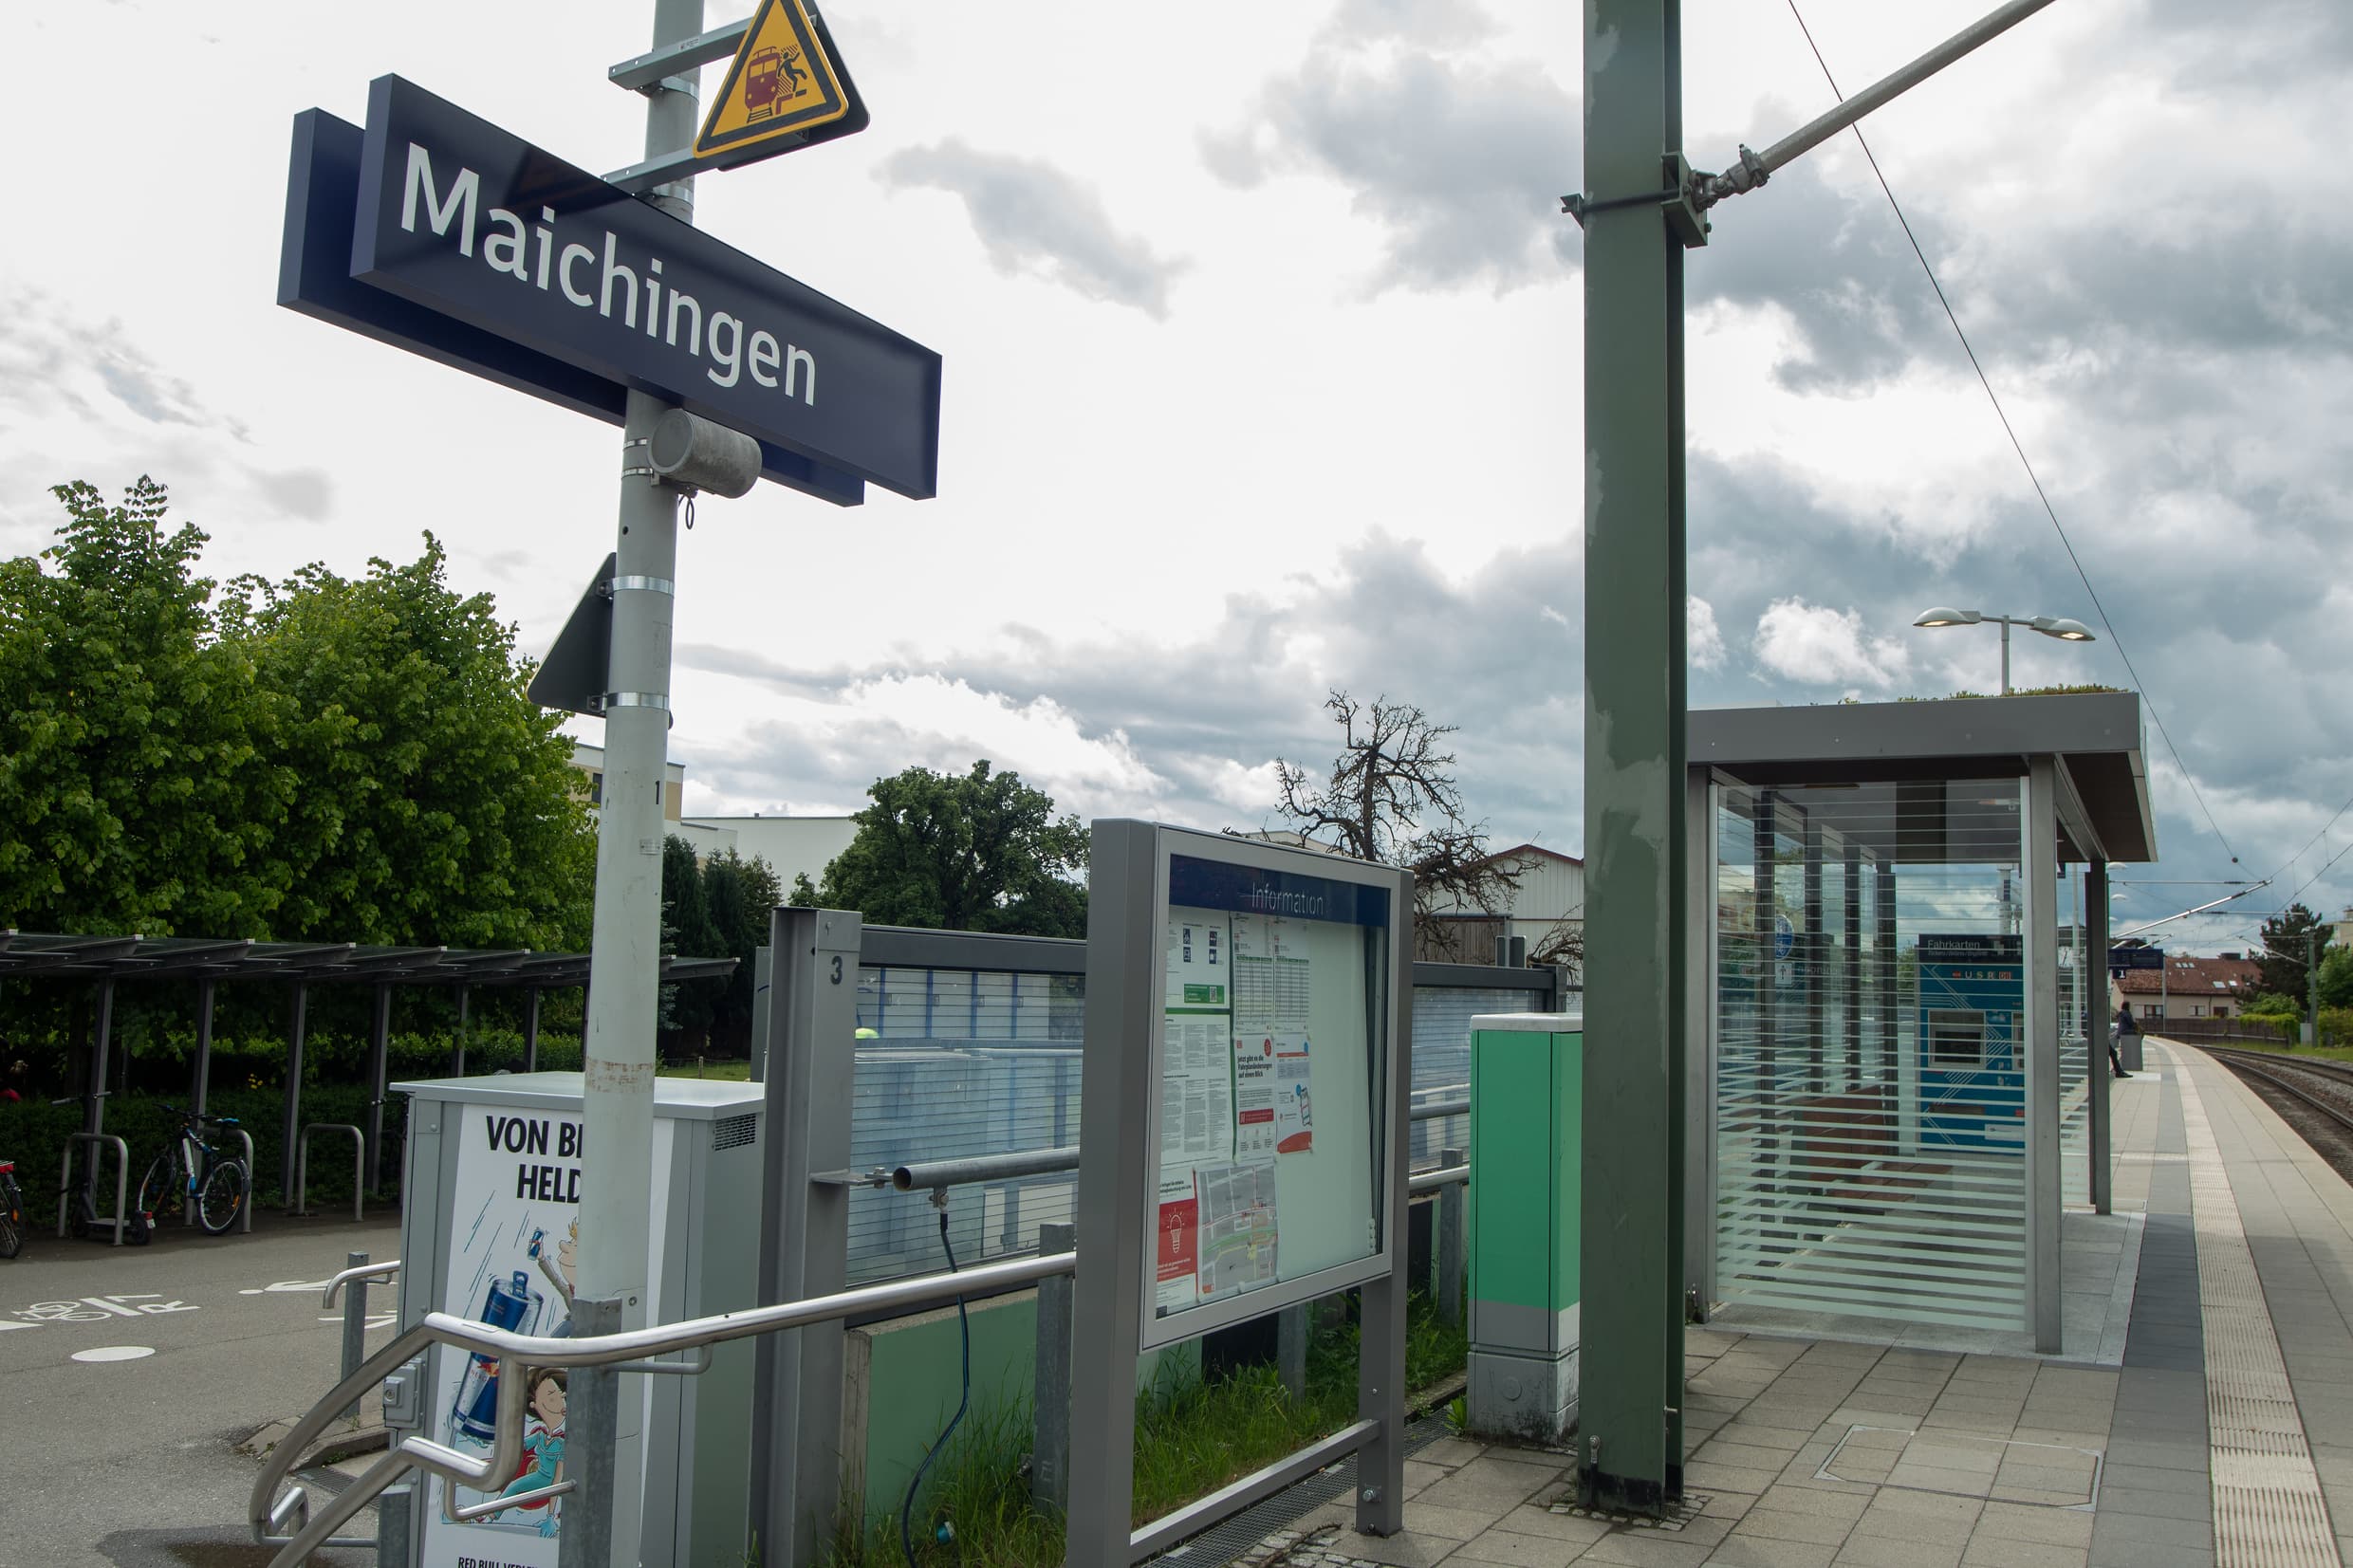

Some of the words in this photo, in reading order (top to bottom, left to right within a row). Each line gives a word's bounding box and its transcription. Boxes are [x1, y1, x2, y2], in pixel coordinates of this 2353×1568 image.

[400, 141, 817, 406] Maichingen
[1251, 880, 1324, 916] Information
[1927, 939, 1980, 950] Fahrkarten
[830, 955, 843, 986] 3
[2118, 969, 2126, 979] 1
[486, 1116, 549, 1155] VON
[458, 1557, 476, 1568] RED
